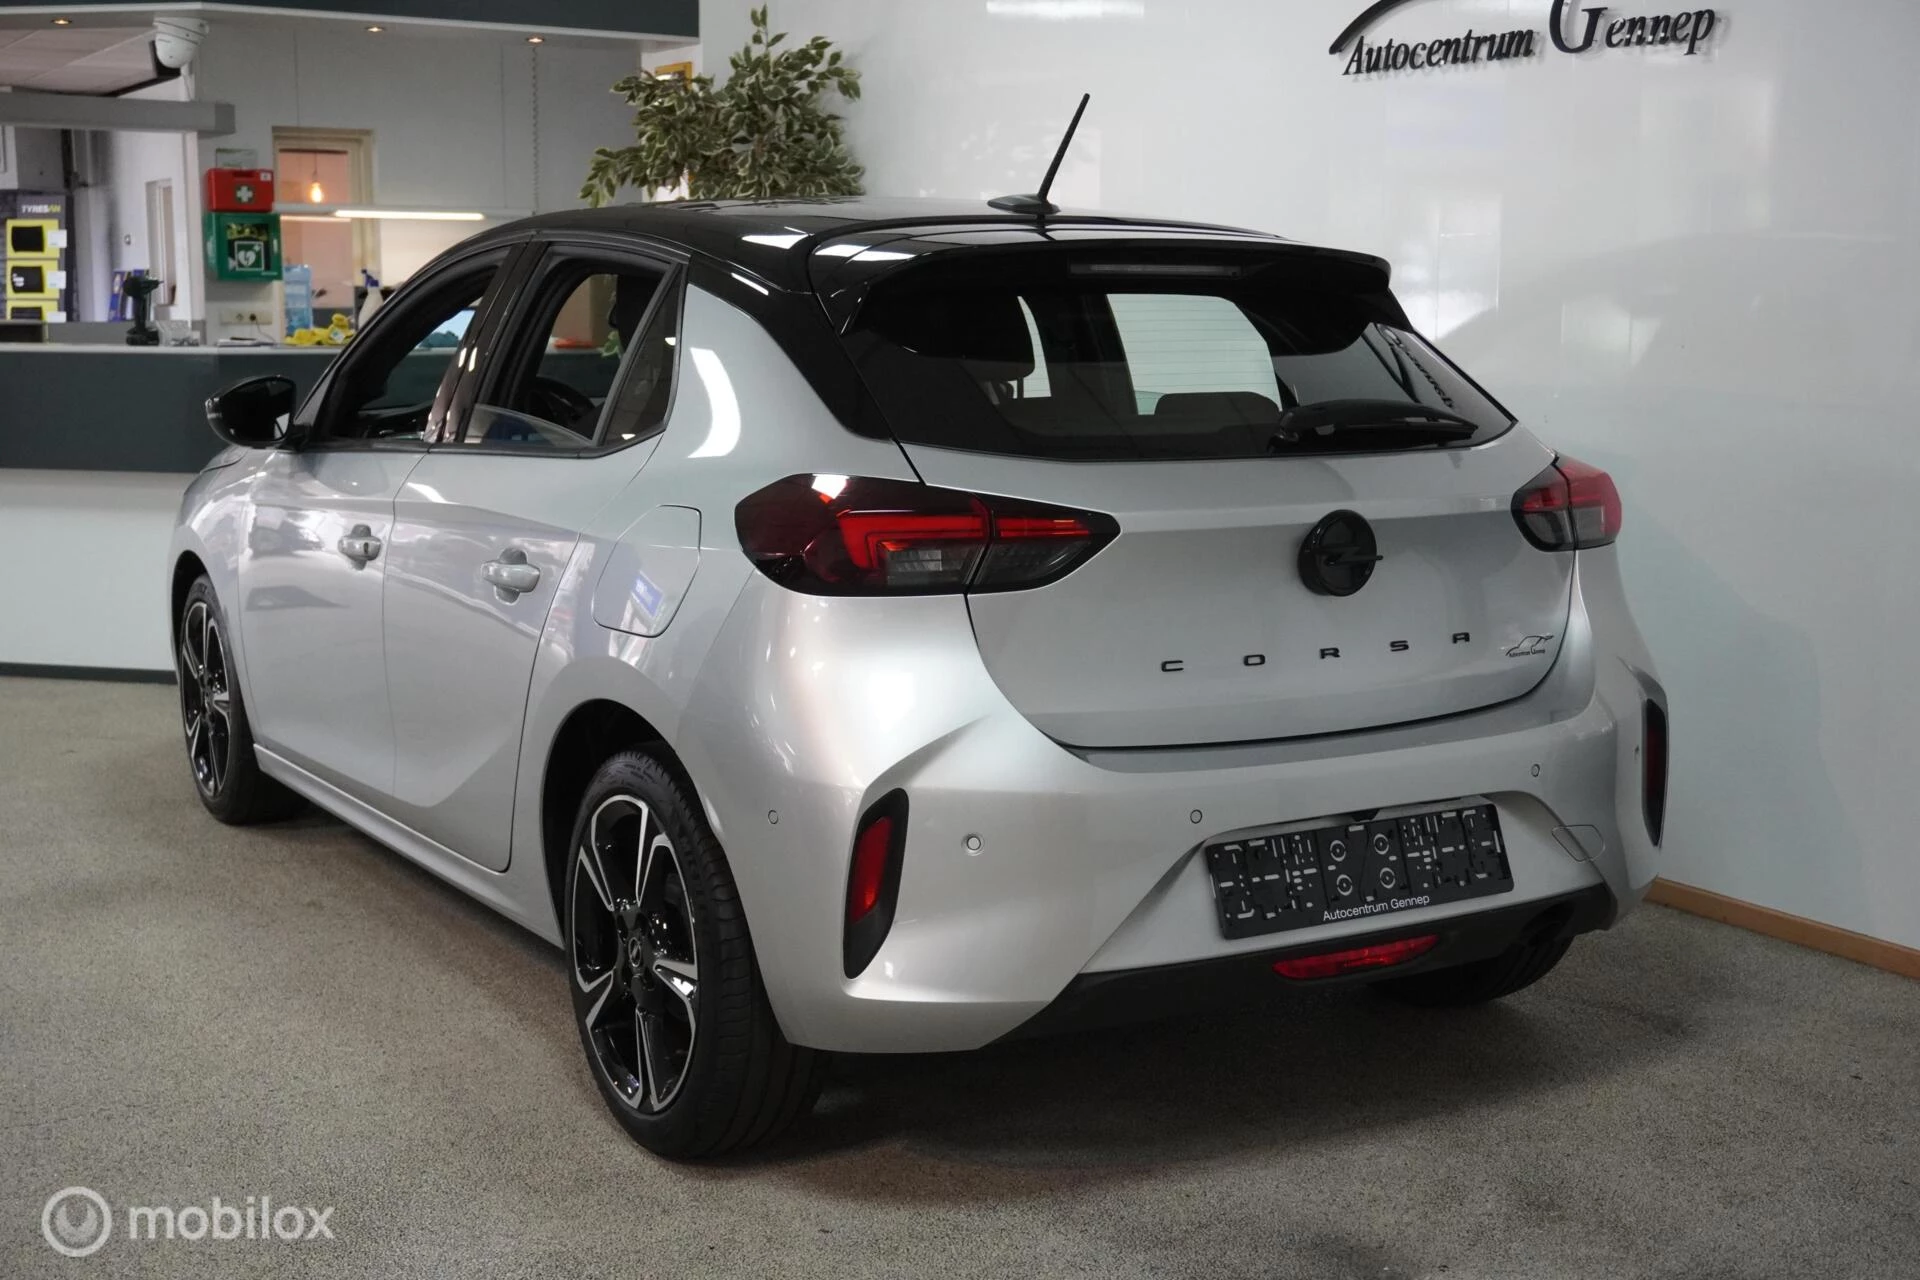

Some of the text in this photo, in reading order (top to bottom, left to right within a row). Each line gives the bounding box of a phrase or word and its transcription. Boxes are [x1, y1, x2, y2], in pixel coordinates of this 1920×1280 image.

[1342, 0, 1716, 76] Autocentrum Gennep
[1160, 631, 1471, 673] CORSA
[1322, 895, 1430, 921] Autocentrum Gennep
